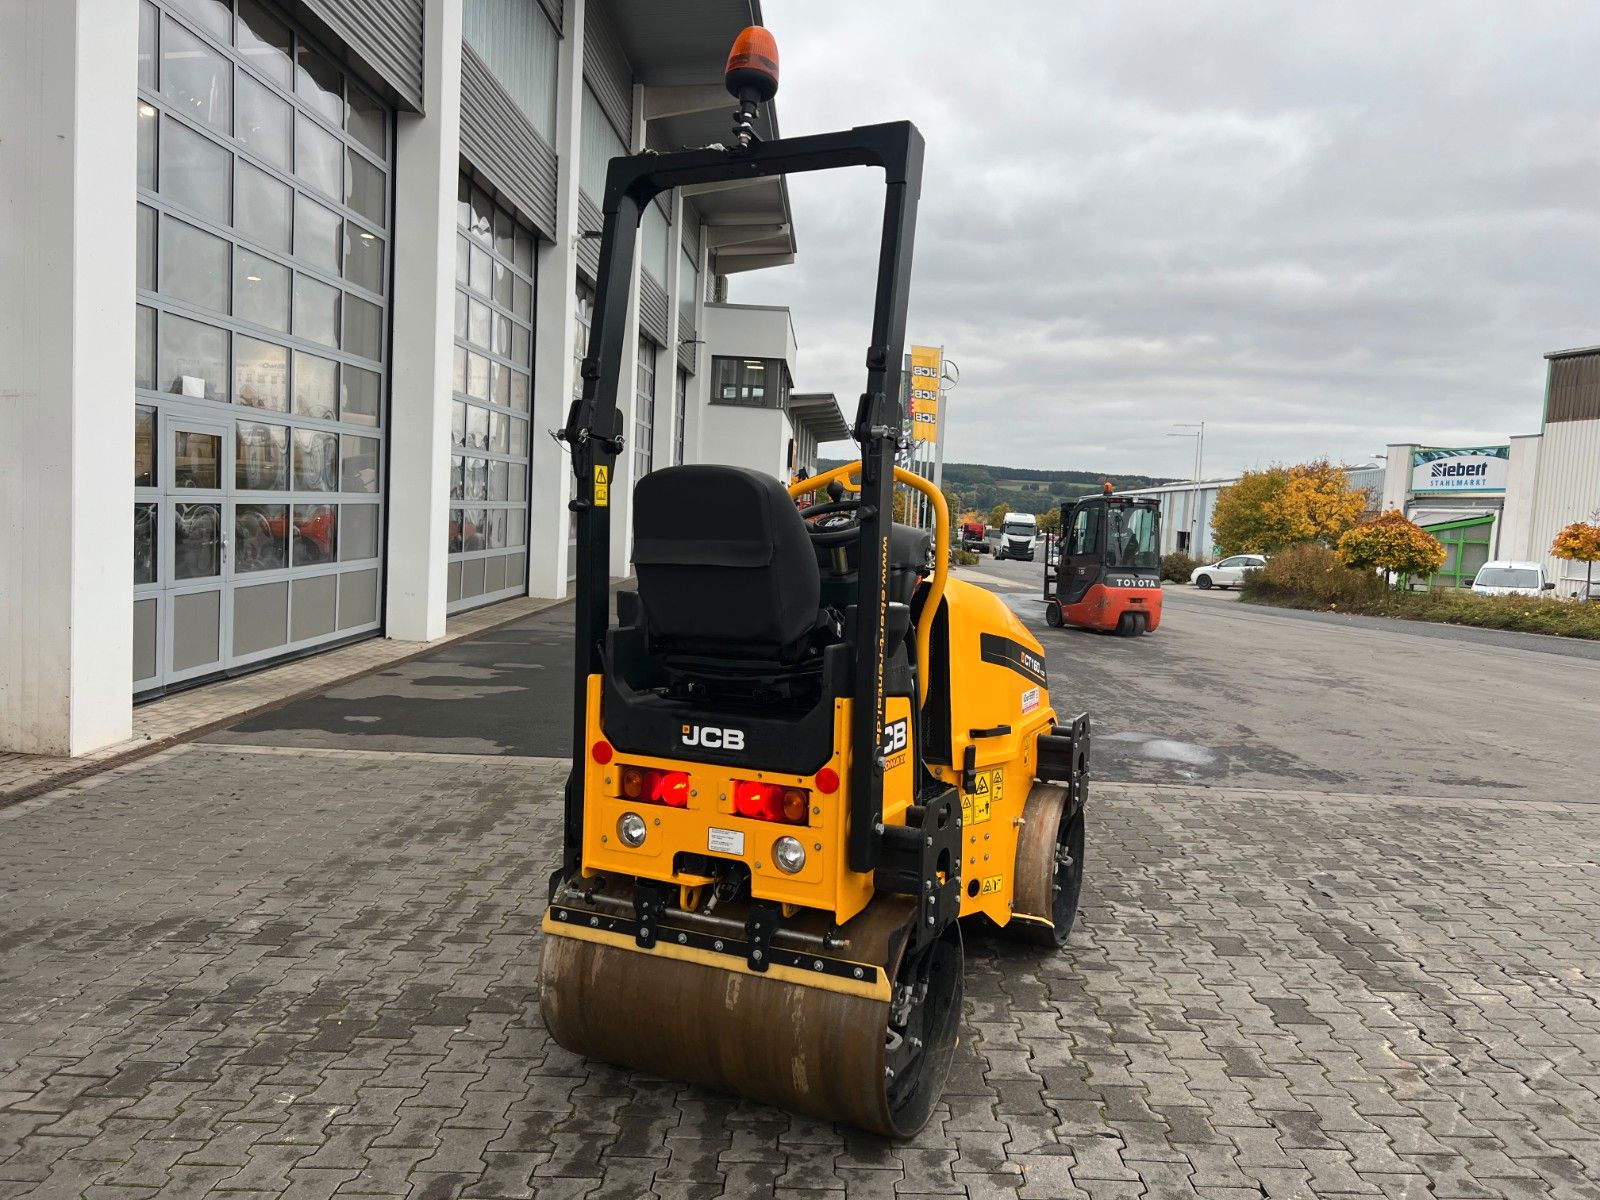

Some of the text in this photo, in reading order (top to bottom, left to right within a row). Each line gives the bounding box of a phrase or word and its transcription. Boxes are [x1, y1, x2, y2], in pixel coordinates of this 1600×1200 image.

[1431, 462, 1488, 477] Siebert
[1430, 479, 1487, 487] STAHLMARKT
[1116, 579, 1156, 587] TOYOTA
[682, 725, 745, 750] JCB
[883, 721, 906, 754] CB
